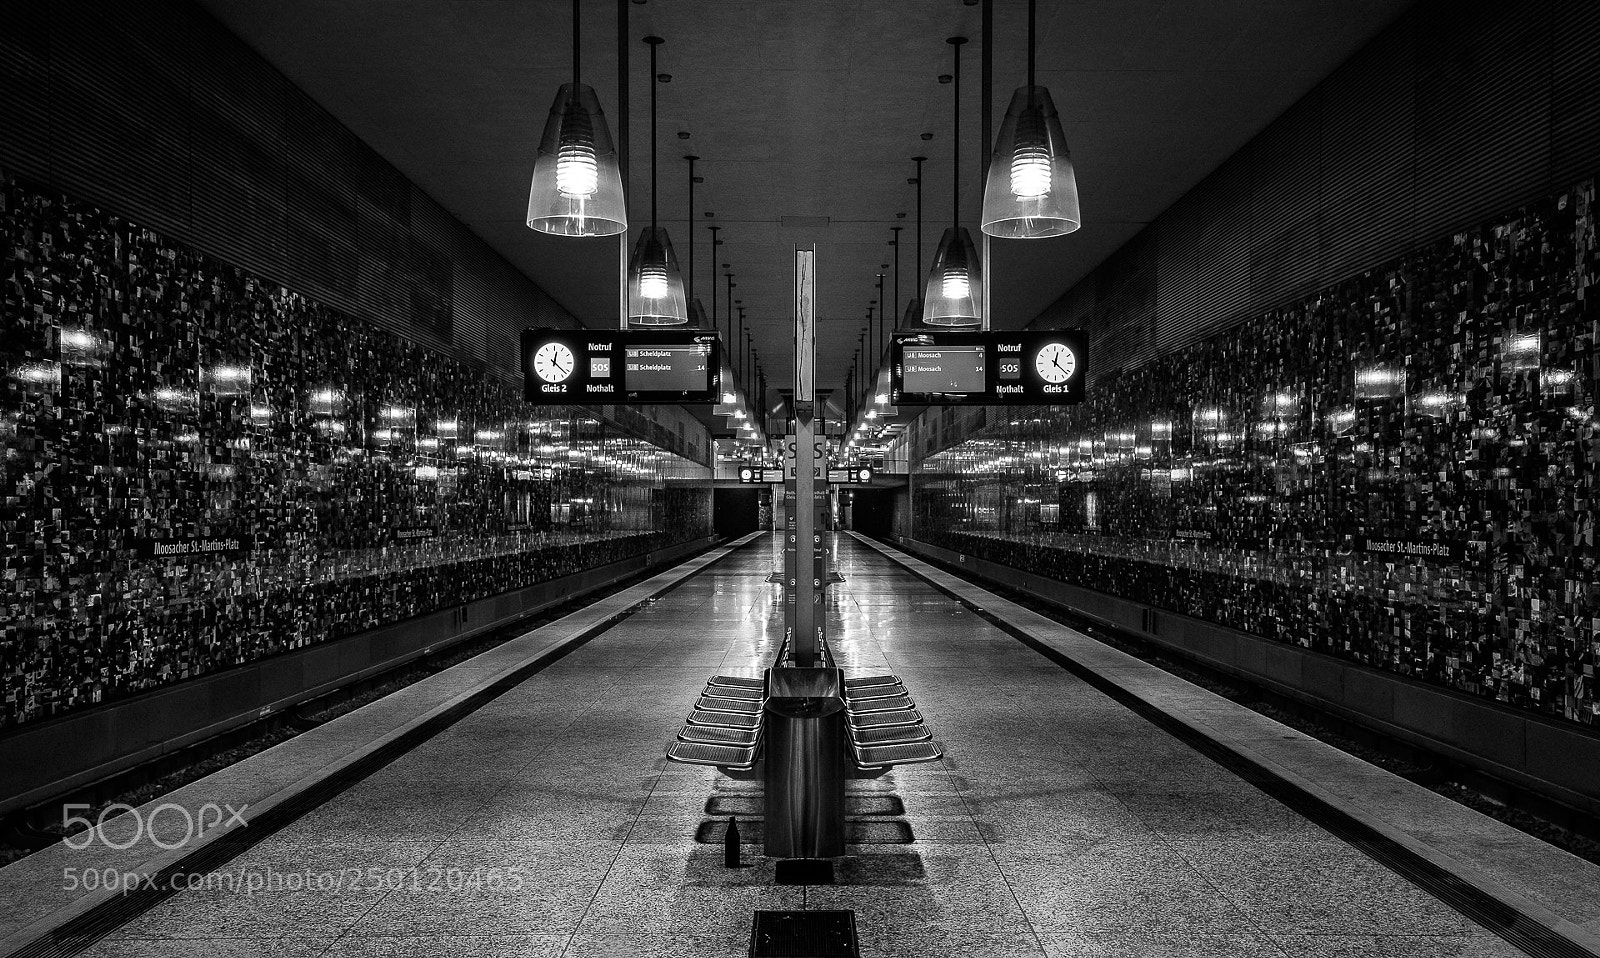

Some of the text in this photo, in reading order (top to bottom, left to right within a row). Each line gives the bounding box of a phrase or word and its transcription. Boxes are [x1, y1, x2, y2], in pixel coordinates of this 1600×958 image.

[588, 342, 612, 351] Notruf
[997, 344, 1022, 352] Notruf
[591, 362, 609, 372] SOS
[917, 365, 942, 373] Moosach
[1001, 364, 1018, 373] SOS
[541, 384, 567, 393] Gleis 2
[586, 384, 614, 393] Nothalt
[996, 385, 1024, 394] Nothalt
[1043, 385, 1069, 393] Gleis 1
[154, 541, 190, 555] Moosacher
[1366, 539, 1396, 553] Moosacher
